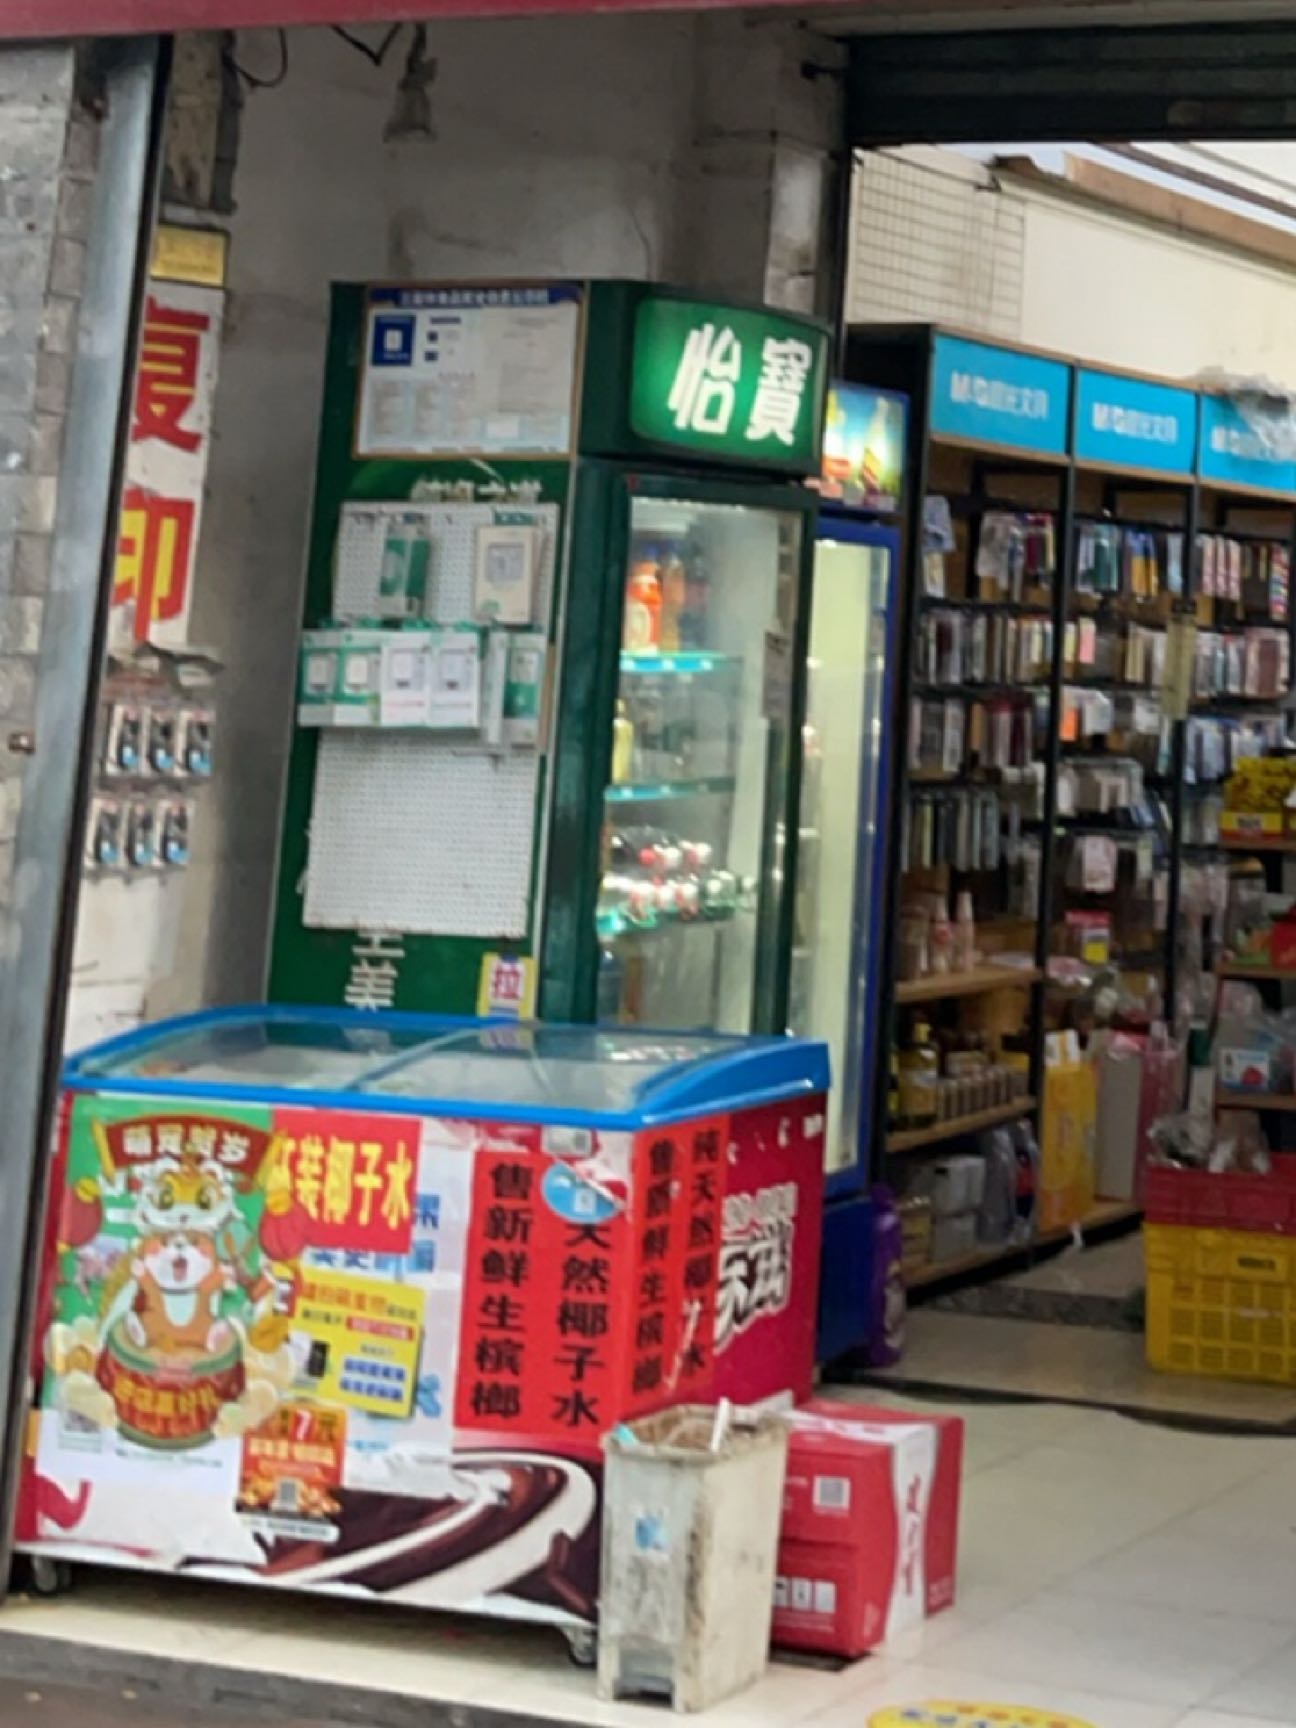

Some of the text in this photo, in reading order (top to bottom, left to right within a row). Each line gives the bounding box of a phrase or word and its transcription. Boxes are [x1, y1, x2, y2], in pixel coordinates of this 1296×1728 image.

[470, 1163, 533, 1418] 售新鲜生槟榔
[552, 1222, 612, 1426] 天然椰子水
